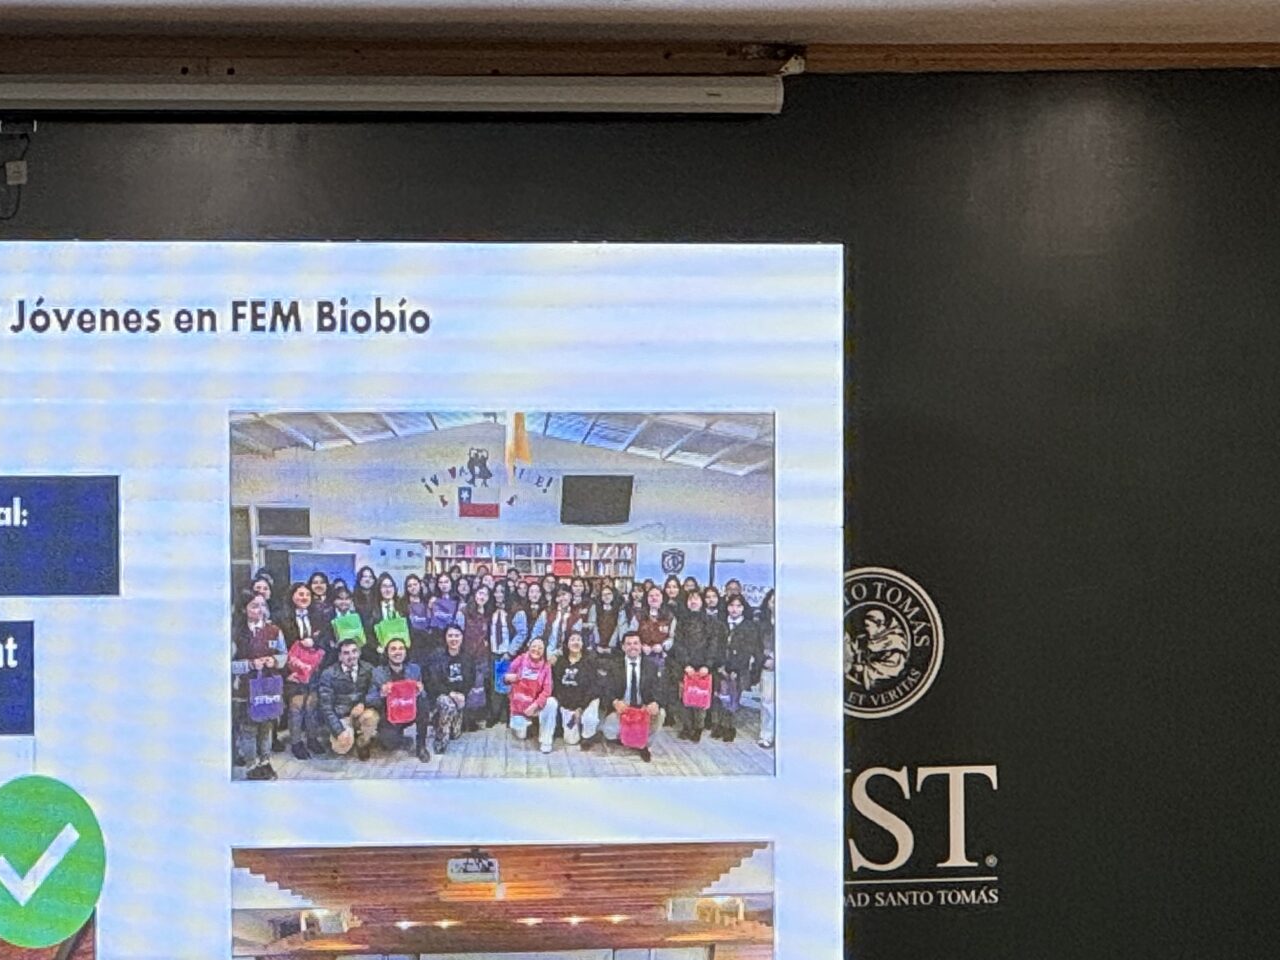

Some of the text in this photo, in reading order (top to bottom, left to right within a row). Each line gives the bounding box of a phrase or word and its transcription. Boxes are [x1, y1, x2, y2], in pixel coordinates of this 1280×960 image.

[10, 297, 161, 333] Jóvenes
[174, 308, 217, 333] en
[231, 299, 302, 333] FEM
[316, 297, 431, 333] Biobío
[870, 668, 922, 706] VERITAS
[844, 764, 998, 873] ST
[874, 890, 934, 907] SANTO
[937, 886, 999, 905] TOMÁS
